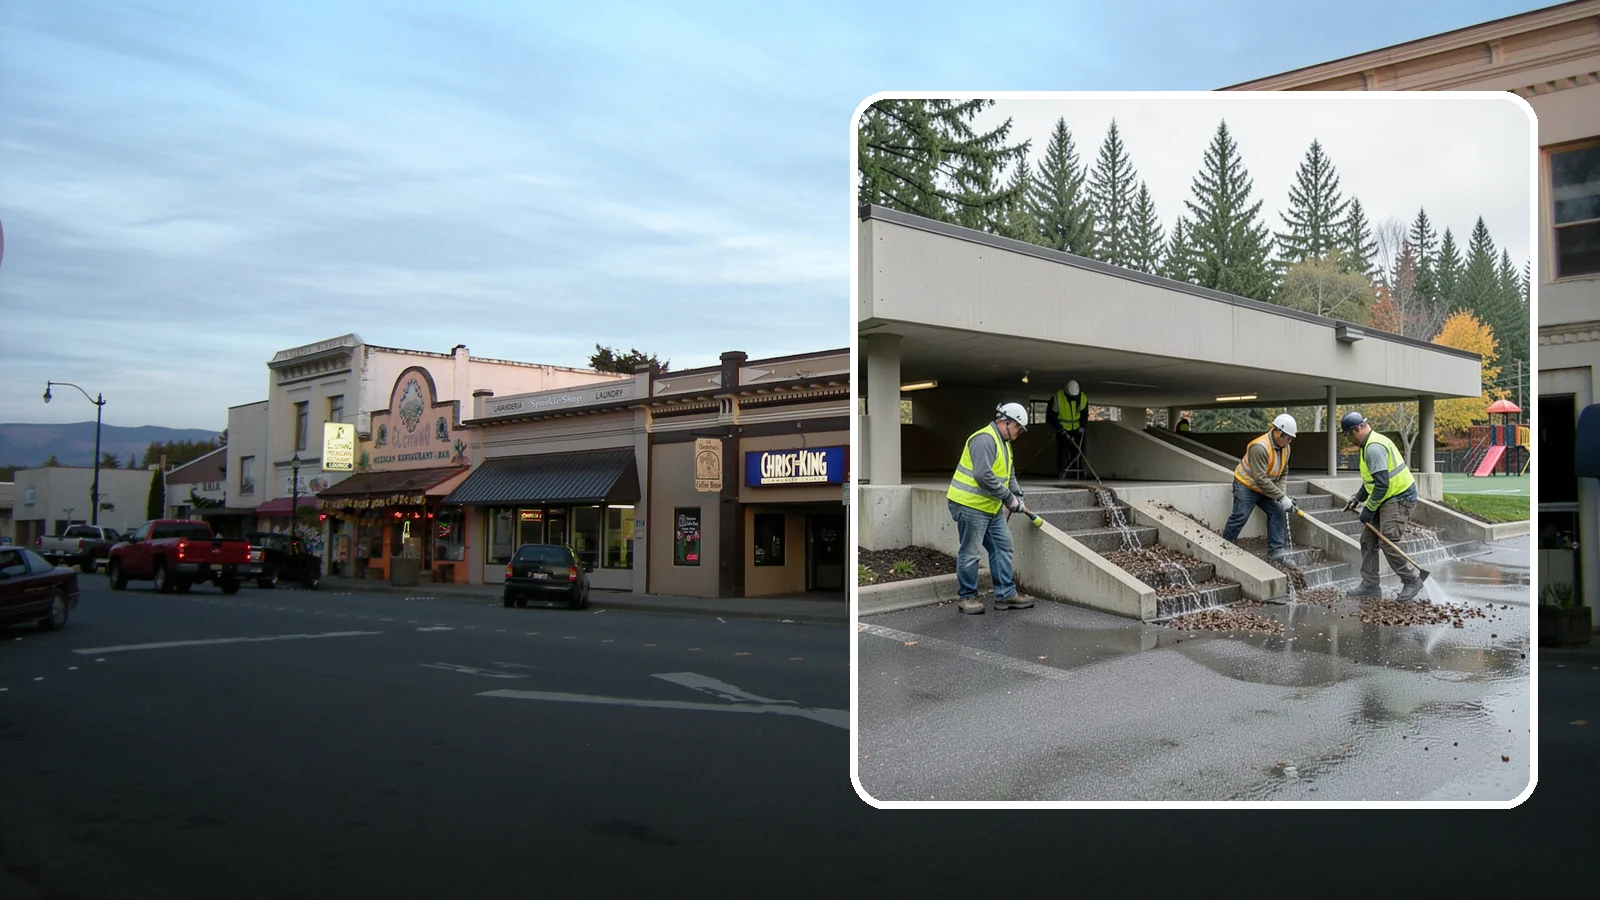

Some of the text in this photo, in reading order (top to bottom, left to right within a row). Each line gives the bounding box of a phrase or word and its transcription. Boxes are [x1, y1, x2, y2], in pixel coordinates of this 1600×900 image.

[531, 394, 582, 409] Sparkle Shop
[595, 389, 623, 400] LAUNDRY
[494, 402, 522, 413] LAVANDERIA
[374, 450, 450, 464] MEXICAN RESTAURANT BAR
[761, 450, 827, 477] CHRIST KING
